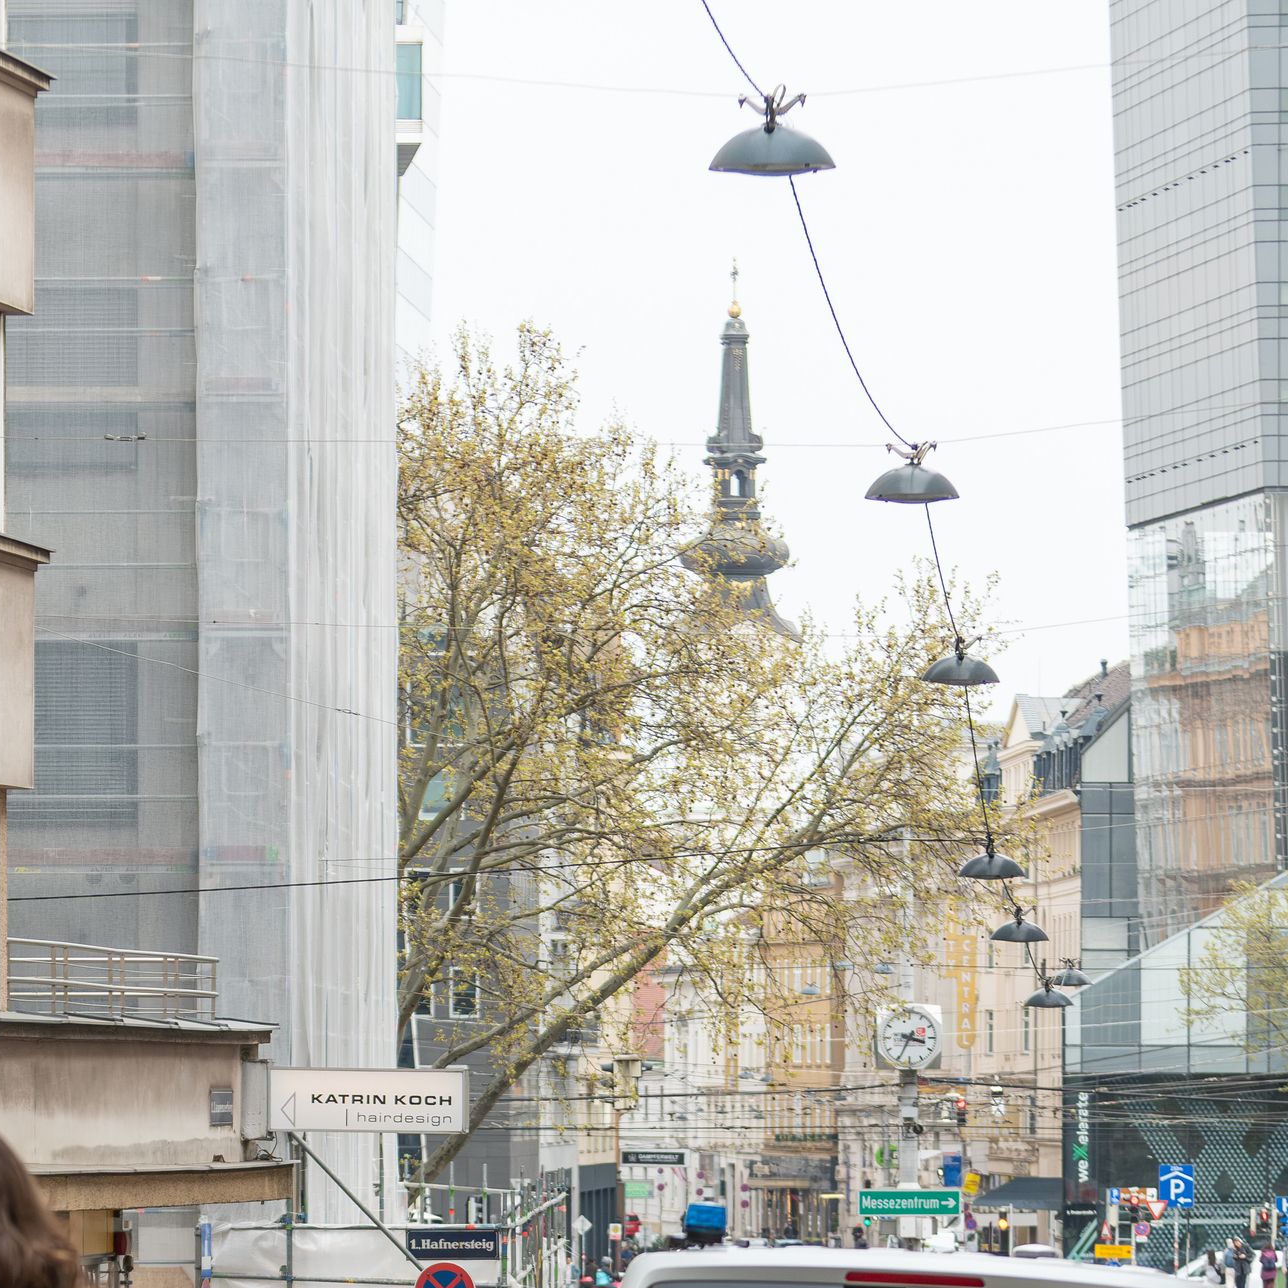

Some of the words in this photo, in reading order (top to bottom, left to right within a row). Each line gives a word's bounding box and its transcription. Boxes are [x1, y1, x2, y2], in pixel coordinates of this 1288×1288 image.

[311, 1094, 386, 1105] KATRIN
[394, 1094, 453, 1106] KOCH
[357, 1112, 452, 1127] hairdesign
[1170, 1178, 1185, 1200] P
[862, 1195, 940, 1209] Messezentrum
